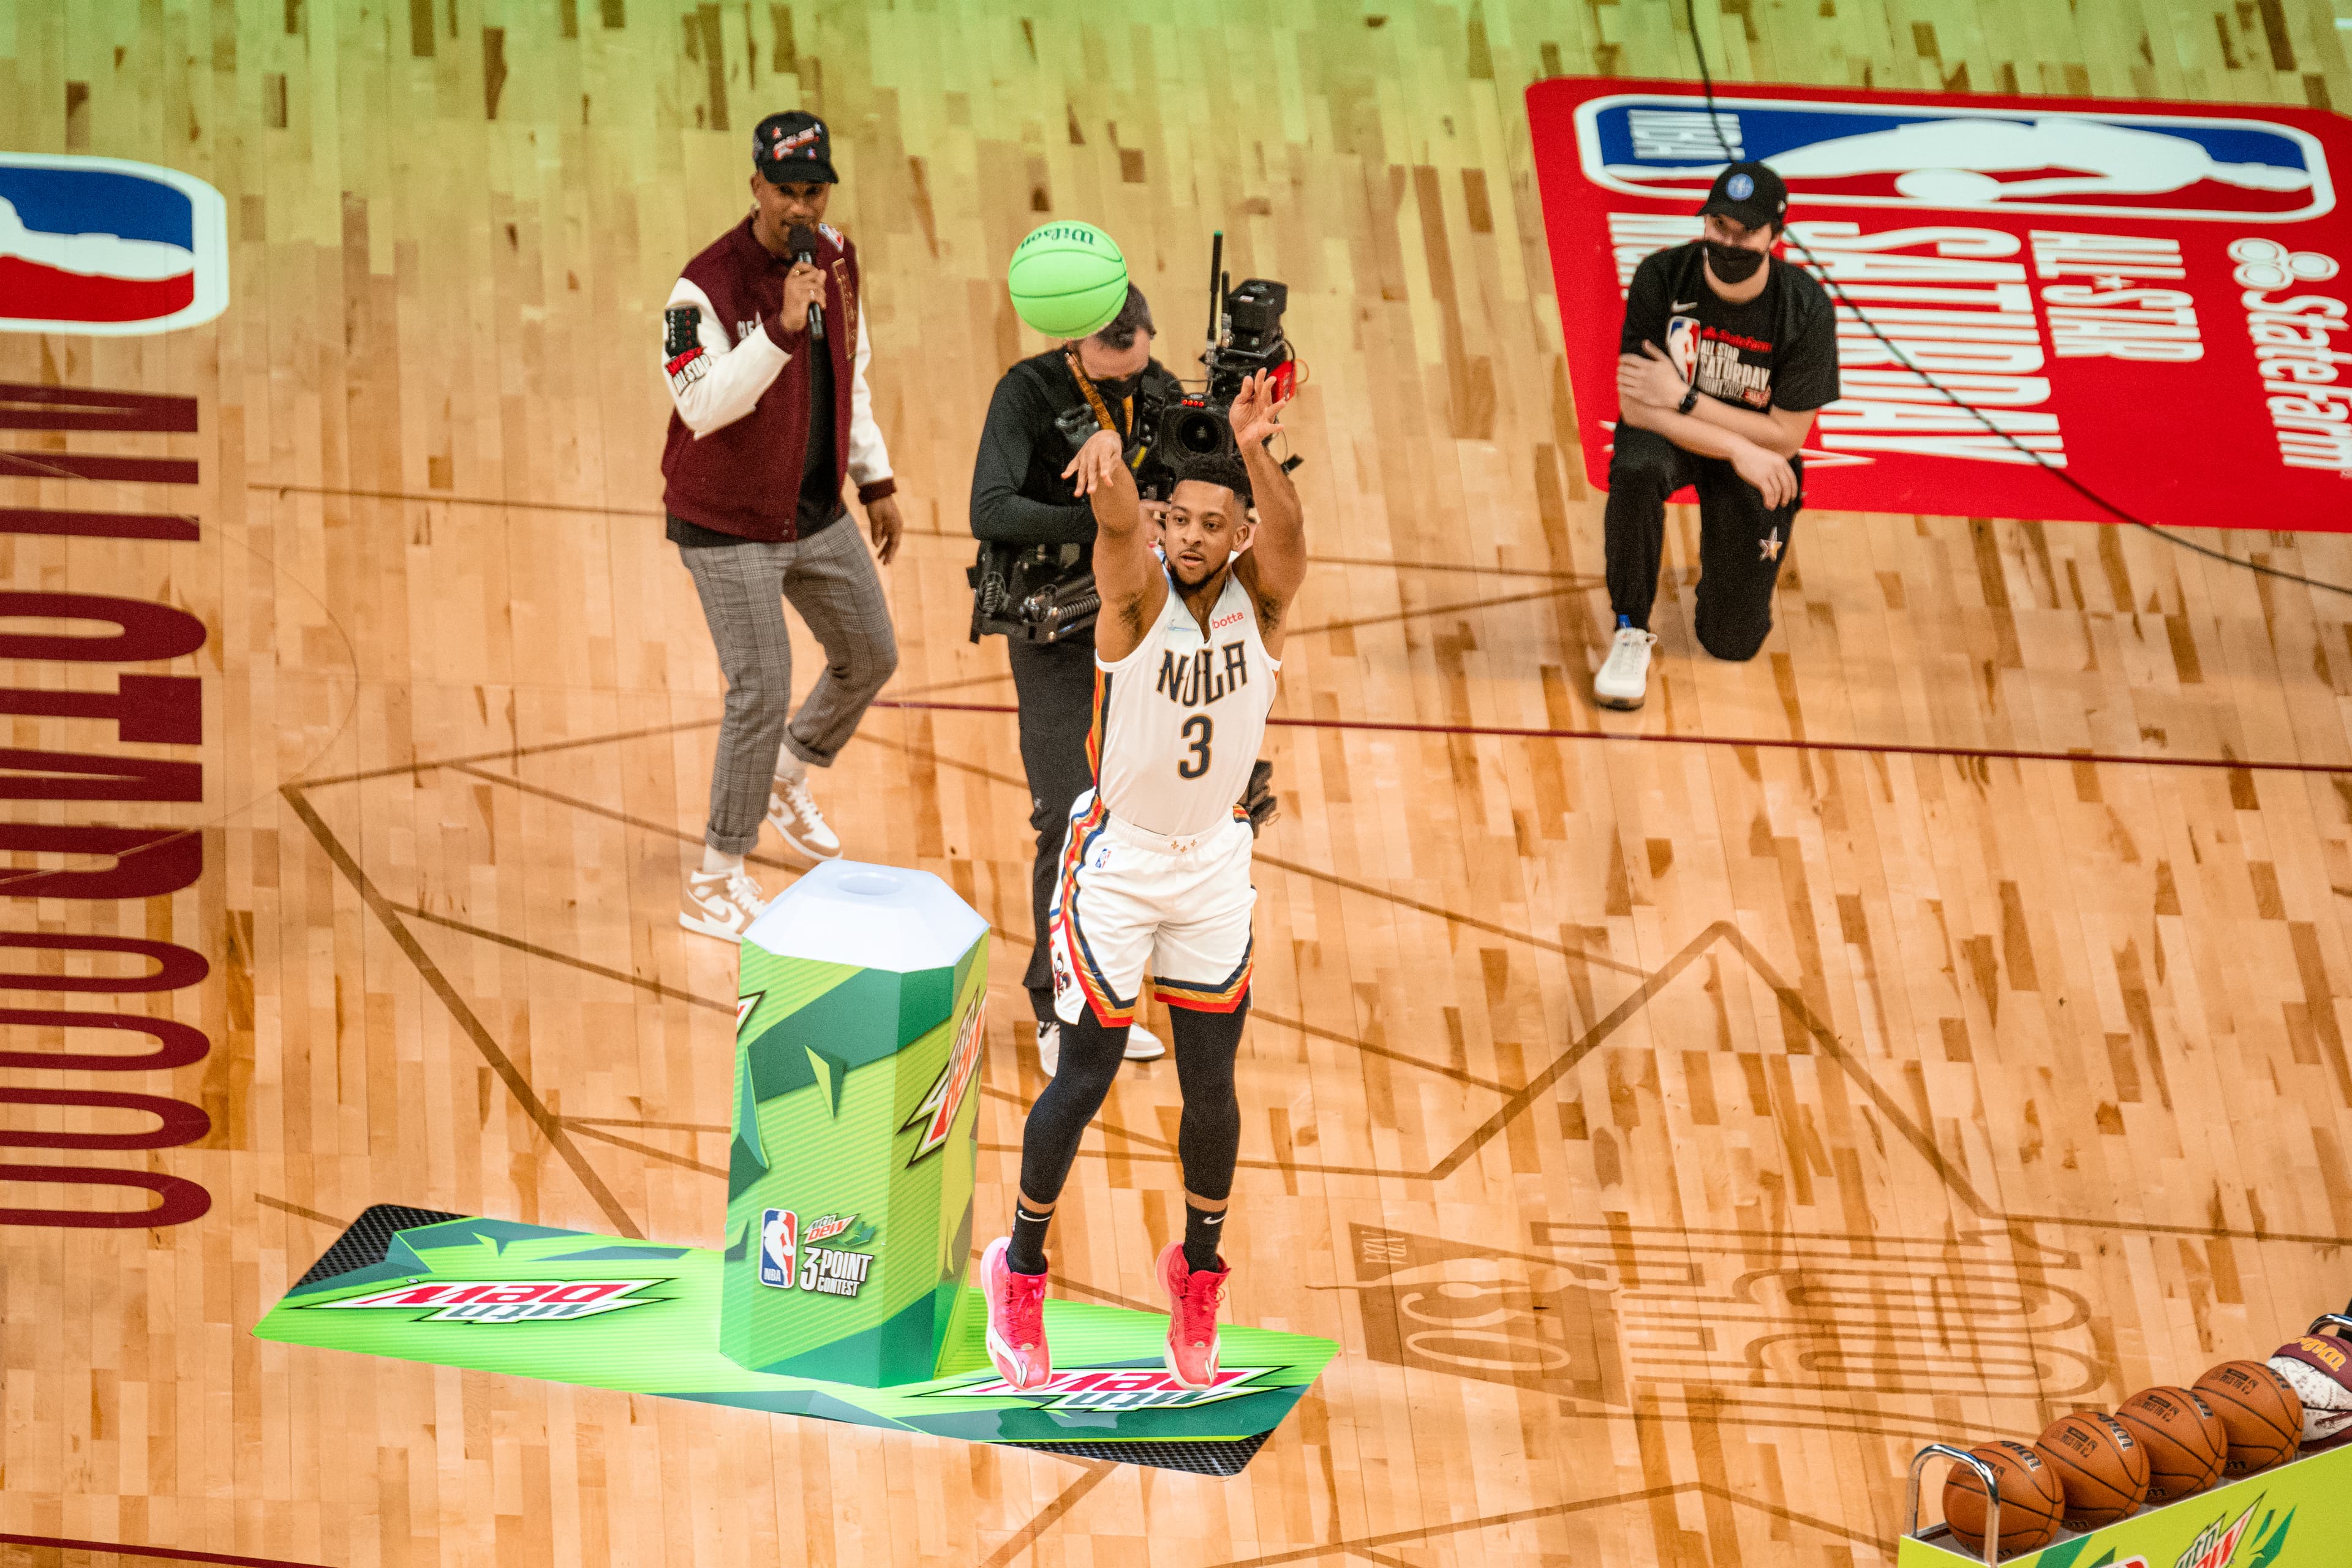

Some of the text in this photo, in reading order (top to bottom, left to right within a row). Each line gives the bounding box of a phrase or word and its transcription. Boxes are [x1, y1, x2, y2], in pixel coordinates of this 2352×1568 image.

[1627, 109, 1746, 161] NBA
[1020, 227, 1095, 250] Wilson
[2029, 229, 2205, 363] ALL STAR
[1779, 221, 2068, 468] SATURDAY
[1700, 355, 1771, 392] SATURDAY
[1177, 712, 1215, 781] 3
[1361, 1230, 1415, 1264] NBA
[763, 1267, 782, 1282] NBA
[818, 1249, 875, 1282] POINT
[816, 1276, 860, 1297] CONTEST
